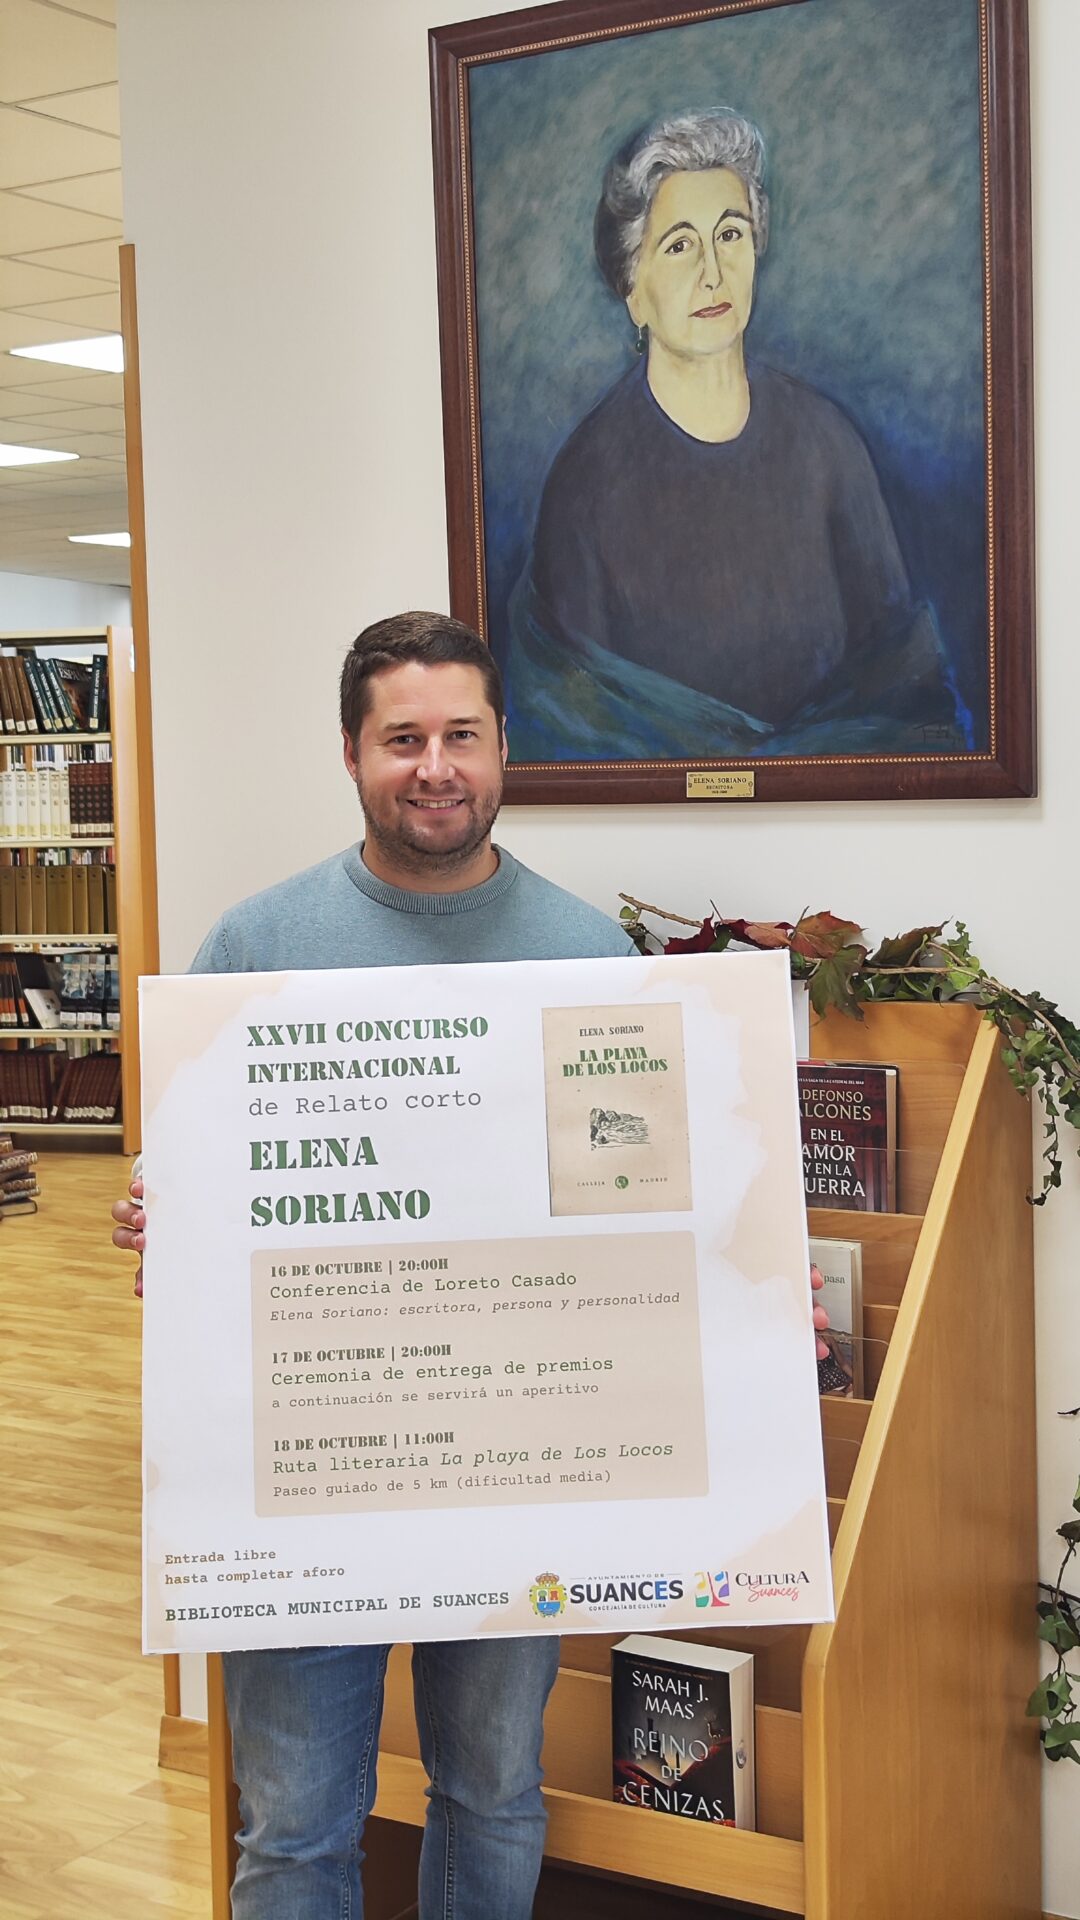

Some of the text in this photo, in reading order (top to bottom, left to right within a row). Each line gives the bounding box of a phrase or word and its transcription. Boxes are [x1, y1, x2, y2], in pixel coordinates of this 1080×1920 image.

[247, 1016, 488, 1046] XXVII CONCURSO
[580, 1026, 644, 1037] ELENA SORIANO
[580, 1047, 648, 1062] LA PLAYA
[248, 1056, 460, 1083] INTERNACIONAL
[563, 1059, 668, 1077] DE LOS LOCOS
[249, 1089, 482, 1116] de Relato corto
[800, 1089, 863, 1102] DEFONSO
[800, 1103, 871, 1120] LCONES
[811, 1129, 844, 1141] EN EL
[250, 1137, 378, 1170] ELENA
[802, 1143, 855, 1161] AMOR
[804, 1163, 852, 1176] Y EN LA
[805, 1178, 865, 1196] UERRA
[251, 1189, 431, 1227] SORIANO
[271, 1265, 287, 1277] 16
[292, 1265, 310, 1276] DE
[315, 1261, 383, 1275] OCTUBRE
[398, 1258, 449, 1271] 20:00H
[270, 1273, 577, 1299] Conferencia de Loreto Casado
[824, 1275, 845, 1284] pasa
[270, 1293, 680, 1321] Elena Soriano: escritora, persona y personalidad
[272, 1352, 288, 1364] 17
[293, 1351, 312, 1363] DE
[317, 1348, 384, 1362] OCTUBRE
[401, 1344, 451, 1357] 20:00H
[271, 1358, 613, 1385] Ceremonia de entrega de premios
[272, 1384, 599, 1408] a continuación se servirá un aperitivo
[274, 1440, 290, 1452] 18
[296, 1439, 314, 1450] DE
[319, 1435, 387, 1449] OCTUBRE
[404, 1432, 454, 1445] 11:00H
[273, 1443, 673, 1473] Ruta literaria La playa de Los Locos
[273, 1470, 611, 1497] Paseo guiado de 5 km (dificultad media)
[165, 1549, 276, 1565] Entrada libre
[165, 1566, 345, 1585] hasta completar aforo
[570, 1580, 683, 1604] SUANCES
[748, 1580, 800, 1602] Suances
[166, 1591, 509, 1621] BIBLIOTECA MUNICIPAL DE SUANCES
[632, 1671, 709, 1703] SARAH J.
[645, 1695, 694, 1719] MAAS
[634, 1727, 708, 1762] REINO
[662, 1765, 681, 1782] DE
[623, 1782, 724, 1821] CENIZAS
